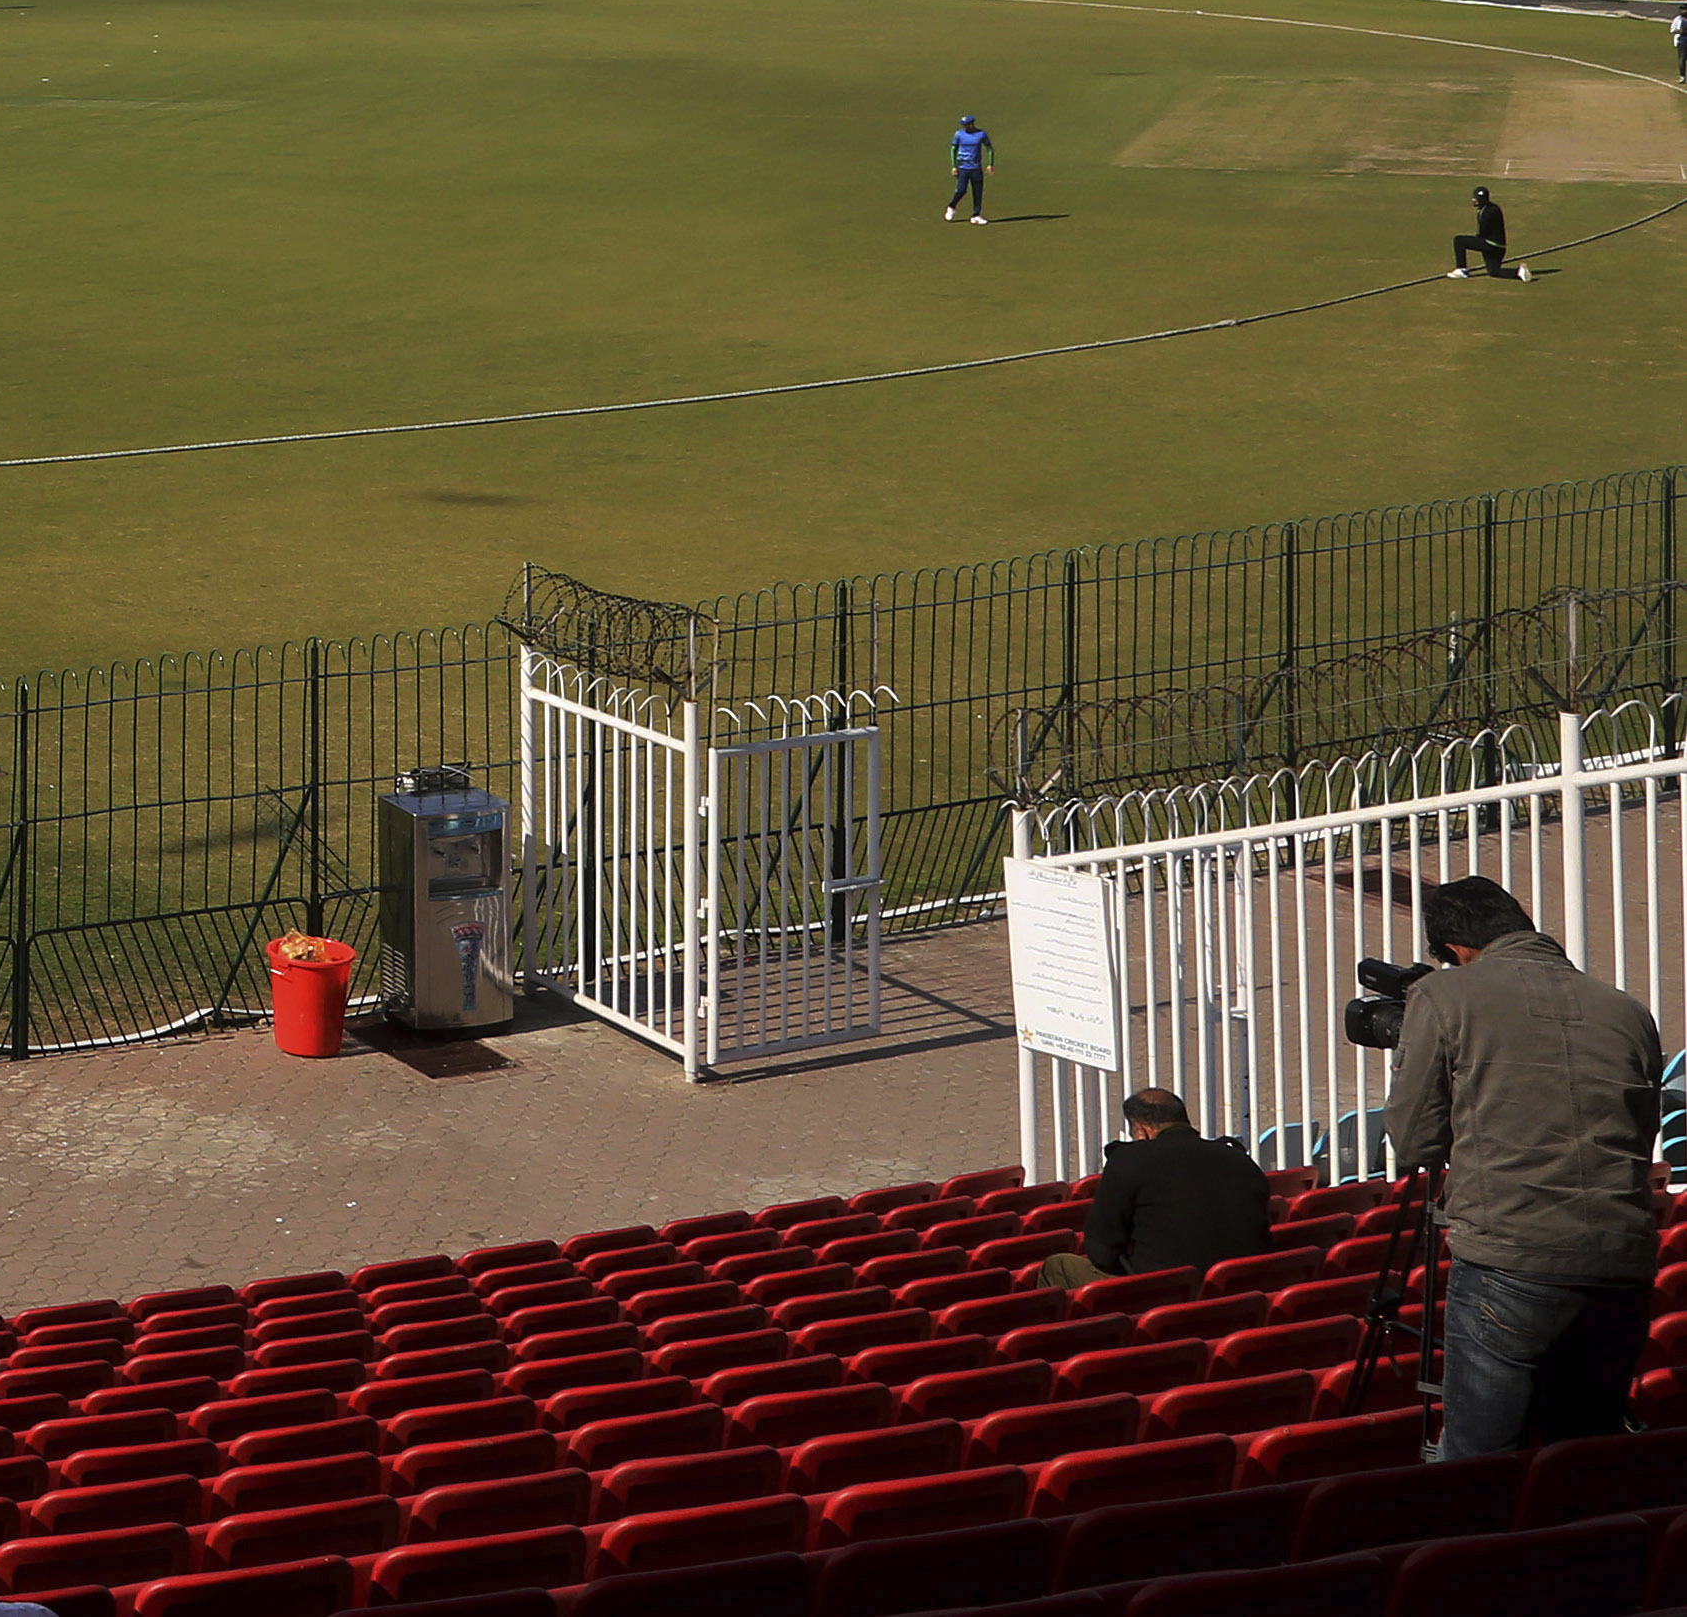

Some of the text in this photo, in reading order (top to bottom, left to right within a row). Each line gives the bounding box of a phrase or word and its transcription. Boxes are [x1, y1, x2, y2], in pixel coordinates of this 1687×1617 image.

[1035, 1030, 1111, 1056] PAKISTAN CRICKET BOARD
